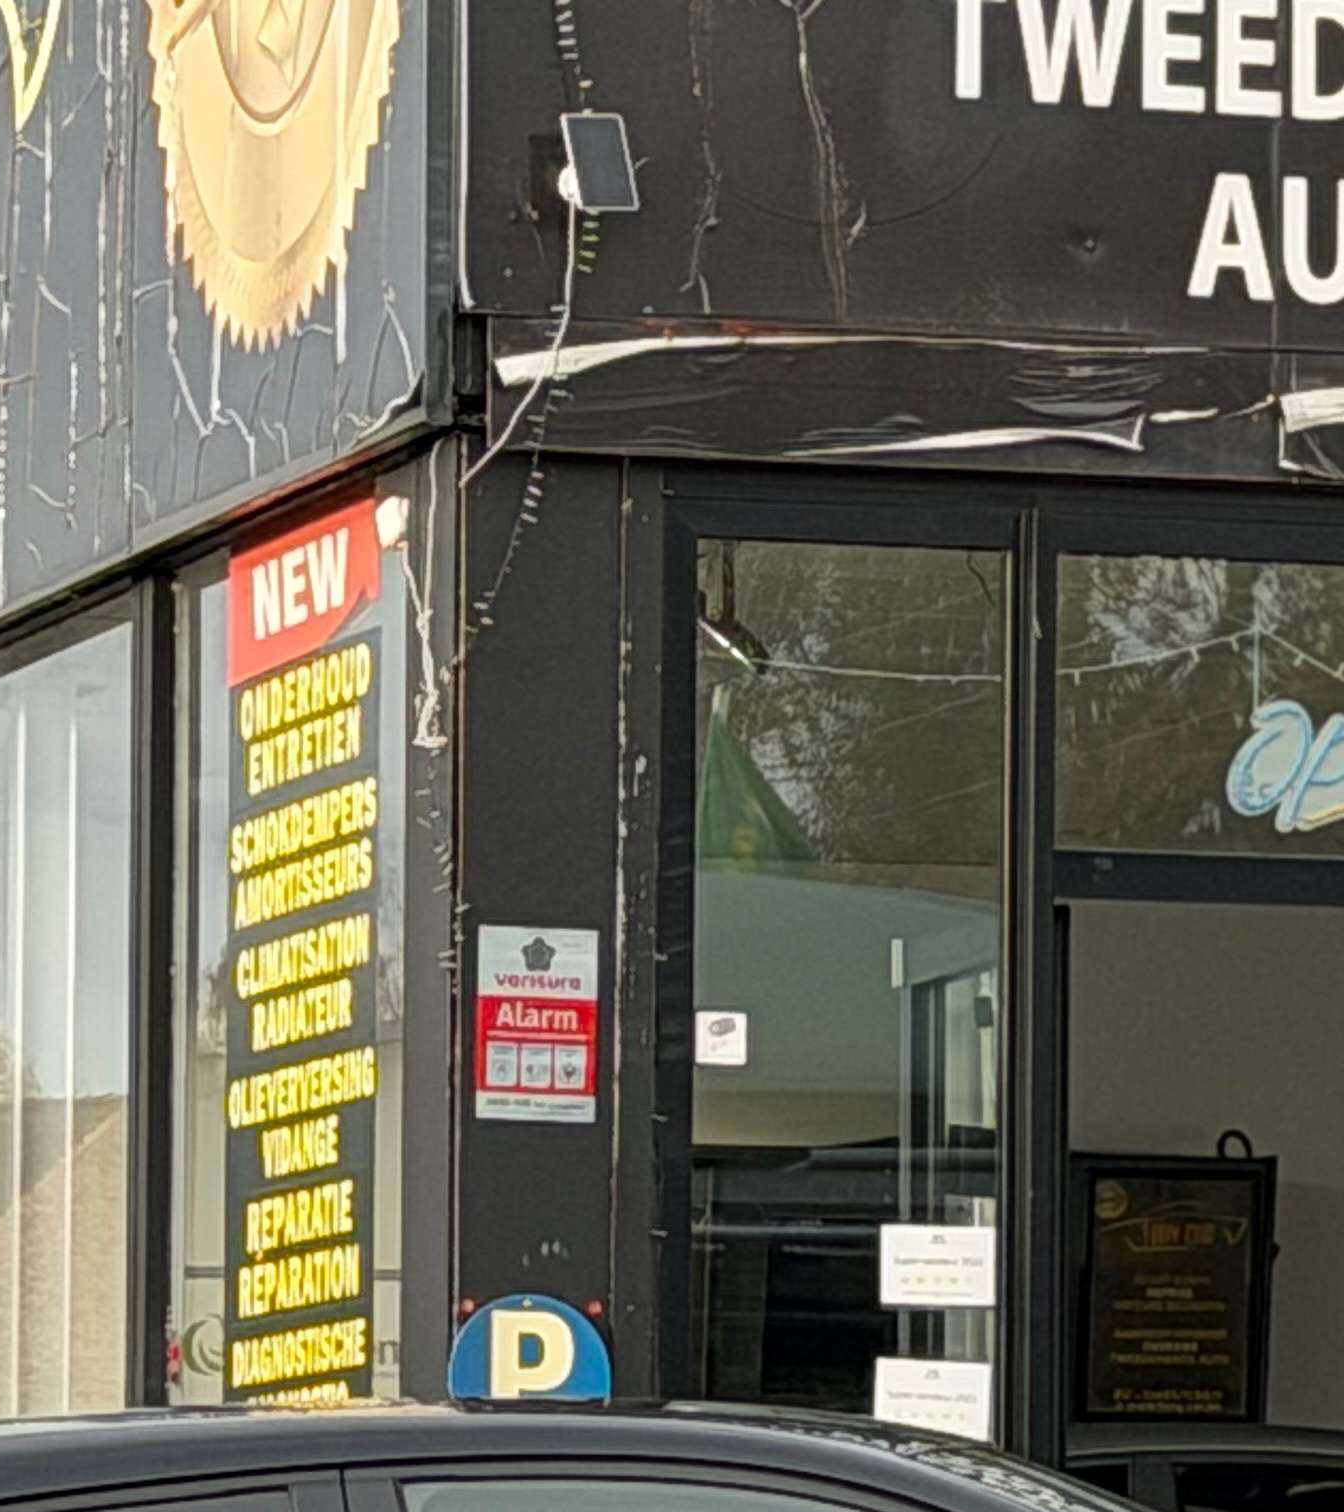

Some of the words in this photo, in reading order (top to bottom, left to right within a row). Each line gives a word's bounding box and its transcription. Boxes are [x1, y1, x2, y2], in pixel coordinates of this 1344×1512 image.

[251, 527, 350, 641] NEW
[240, 643, 371, 741] ONDERHOUD
[247, 703, 361, 796] ENTRETIEN
[230, 777, 376, 874] SCHOKDEMPERS
[234, 837, 372, 931] AMORTISSEURS
[236, 913, 371, 999] CLIMATISATION
[252, 978, 353, 1053] RADIATEUR
[496, 1001, 579, 1031] Alarm
[228, 1046, 375, 1129] OLIEVERVERSING
[261, 1114, 339, 1178] VIDANGE
[247, 1179, 353, 1254] REPARATIE
[231, 1317, 367, 1389] DIAGNOSTISCHE
[489, 1309, 576, 1399] P
